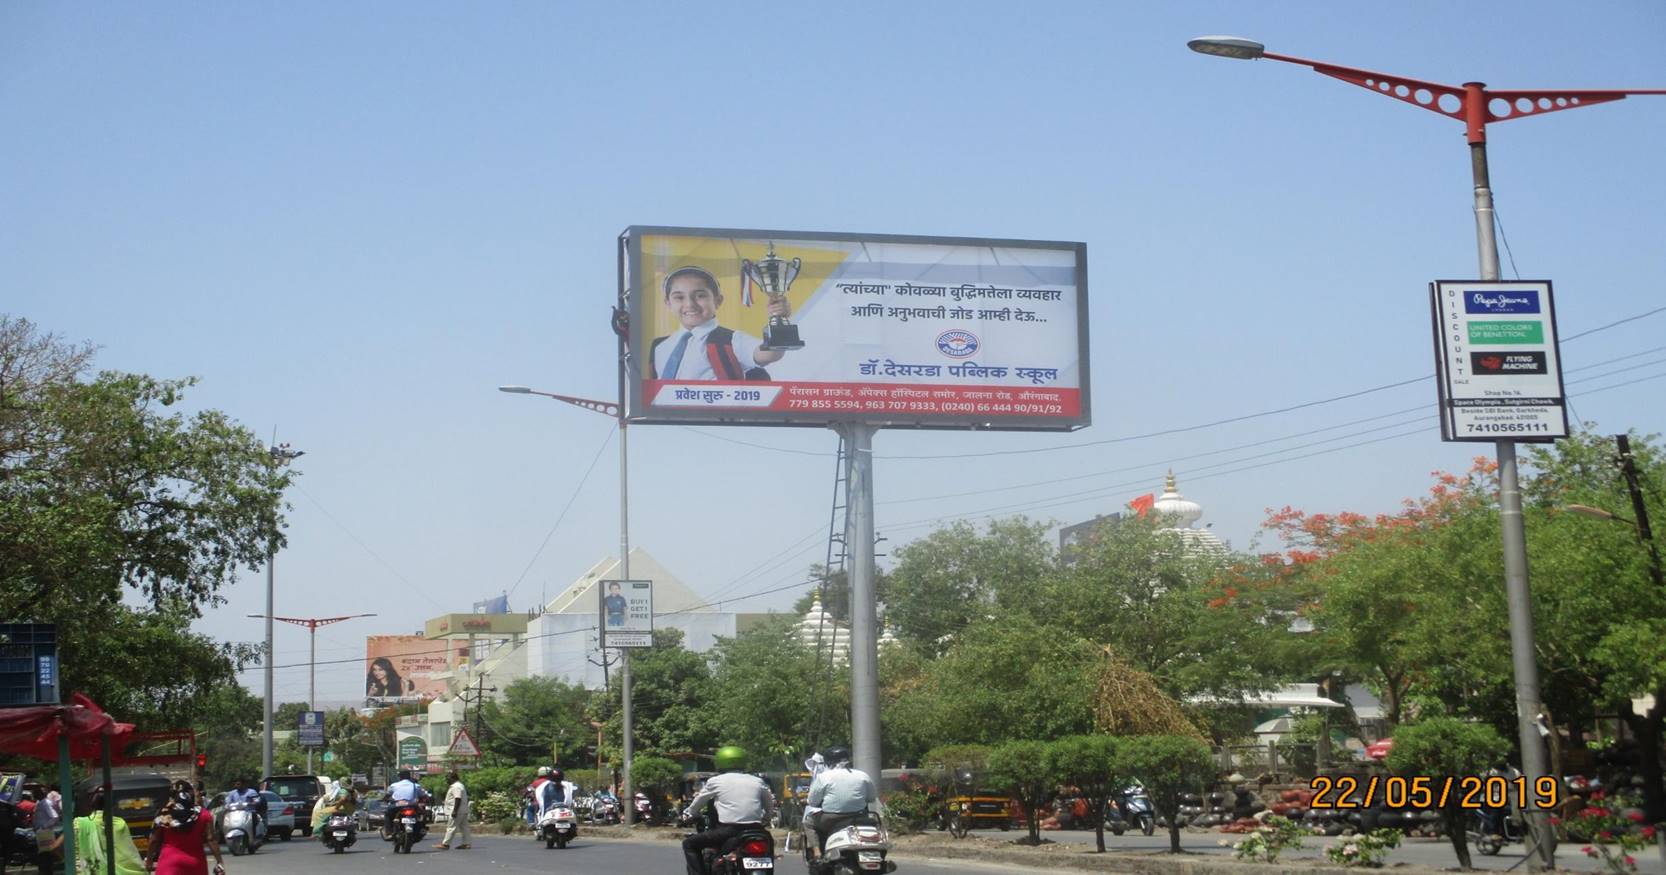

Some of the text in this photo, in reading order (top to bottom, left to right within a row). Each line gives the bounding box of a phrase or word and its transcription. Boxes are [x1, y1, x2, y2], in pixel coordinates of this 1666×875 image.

[894, 282, 946, 297] कोवळ्या
[950, 285, 1013, 301] बुद्धिमत्तेला
[1016, 290, 1062, 301] व्यवहार
[850, 303, 884, 318] आणि
[887, 306, 946, 322] अनुभवाची
[950, 306, 974, 320] जोड
[978, 308, 1011, 322] आम्ही
[948, 360, 1008, 378] पब्लिक
[1016, 367, 1058, 384] स्कूल
[675, 388, 700, 400] प्रवेश
[703, 390, 724, 403] सुरु
[734, 390, 760, 401] 2019
[890, 388, 929, 398] हॉस्पिटल
[933, 390, 959, 400] समोर,
[963, 391, 992, 400] जालना
[996, 391, 1013, 400] रोड,
[790, 399, 1062, 414] 779 855 5594, 963 707 9333, (0240) 66 444 90/91/92
[1466, 423, 1548, 432] 7410565111
